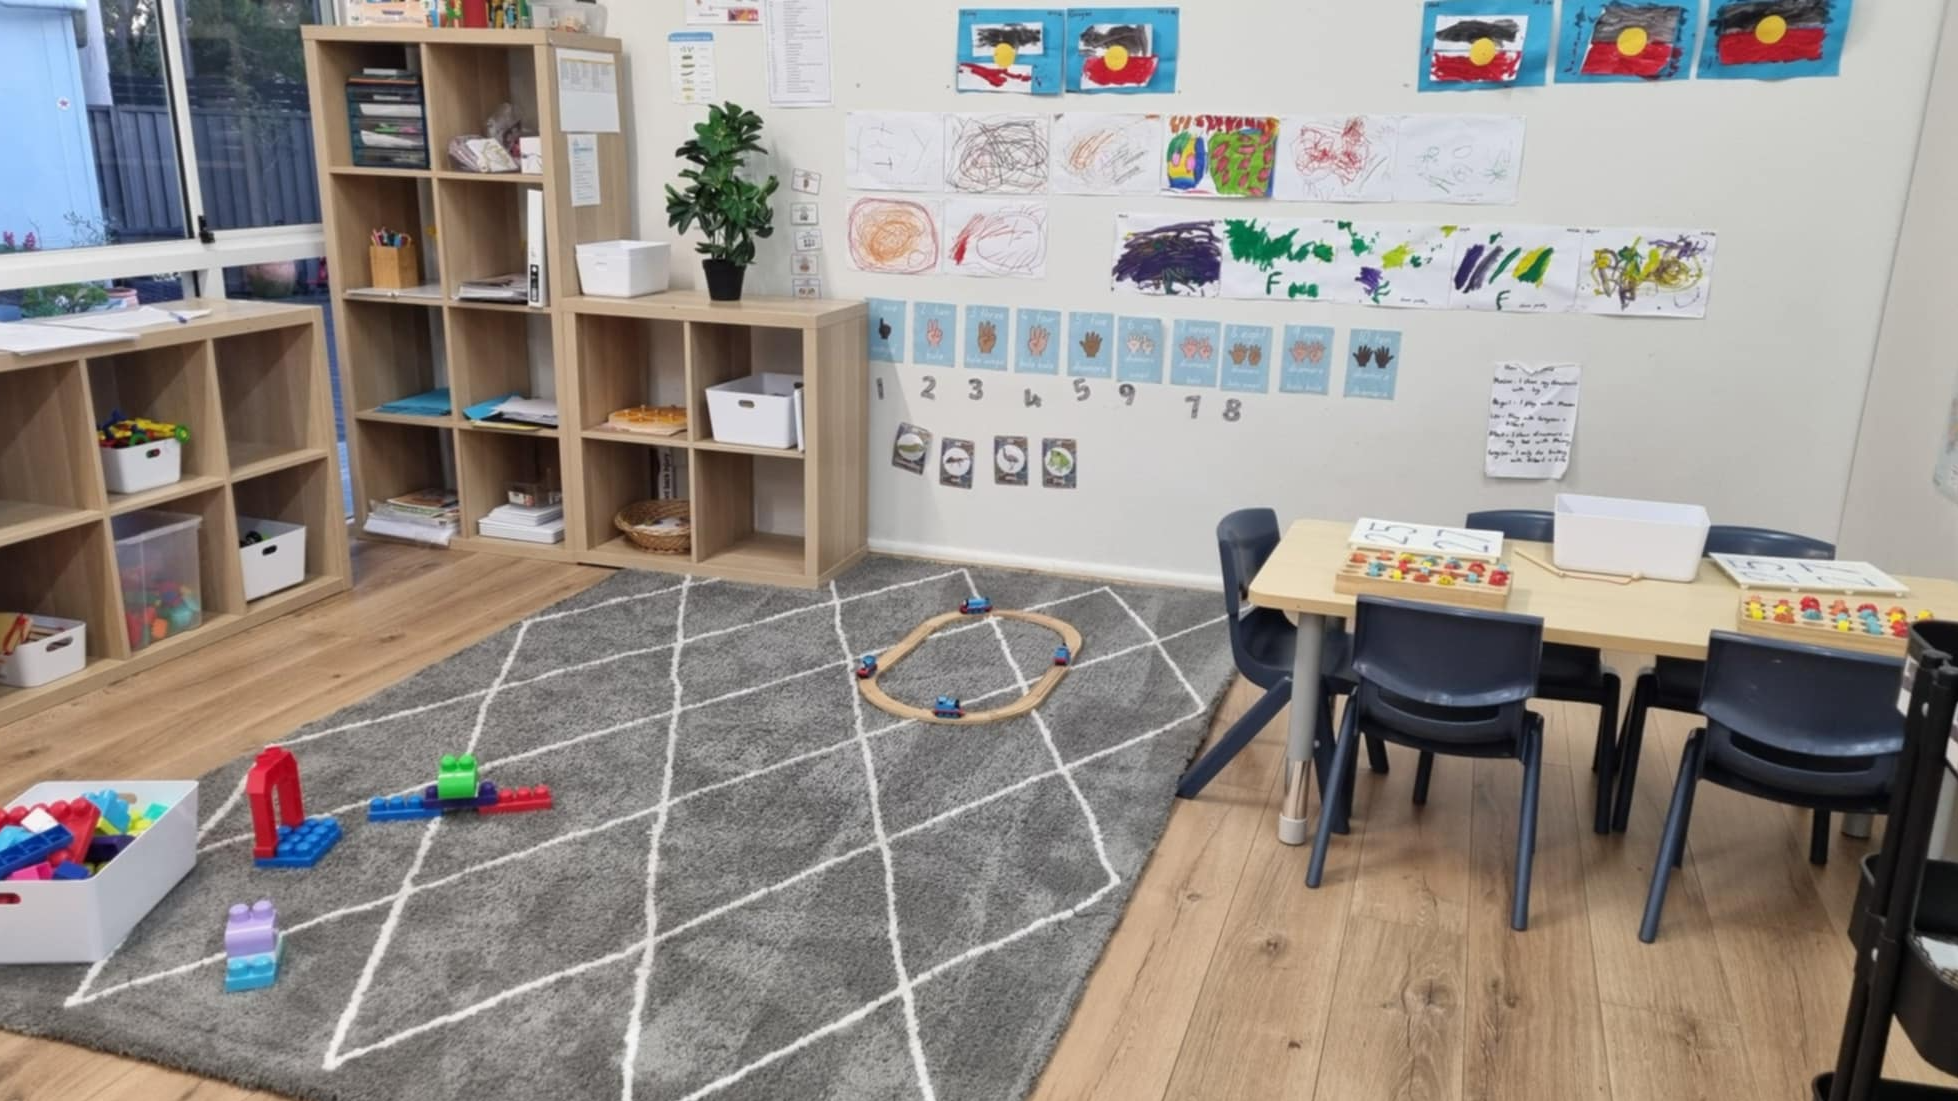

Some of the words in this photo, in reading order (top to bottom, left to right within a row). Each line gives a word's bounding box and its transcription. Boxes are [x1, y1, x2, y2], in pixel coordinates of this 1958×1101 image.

[921, 376, 937, 400] 2
[968, 378, 984, 400] 3
[1024, 388, 1042, 408] 4
[1073, 378, 1091, 401] 5
[1184, 394, 1201, 419] 7
[1222, 398, 1242, 422] 8
